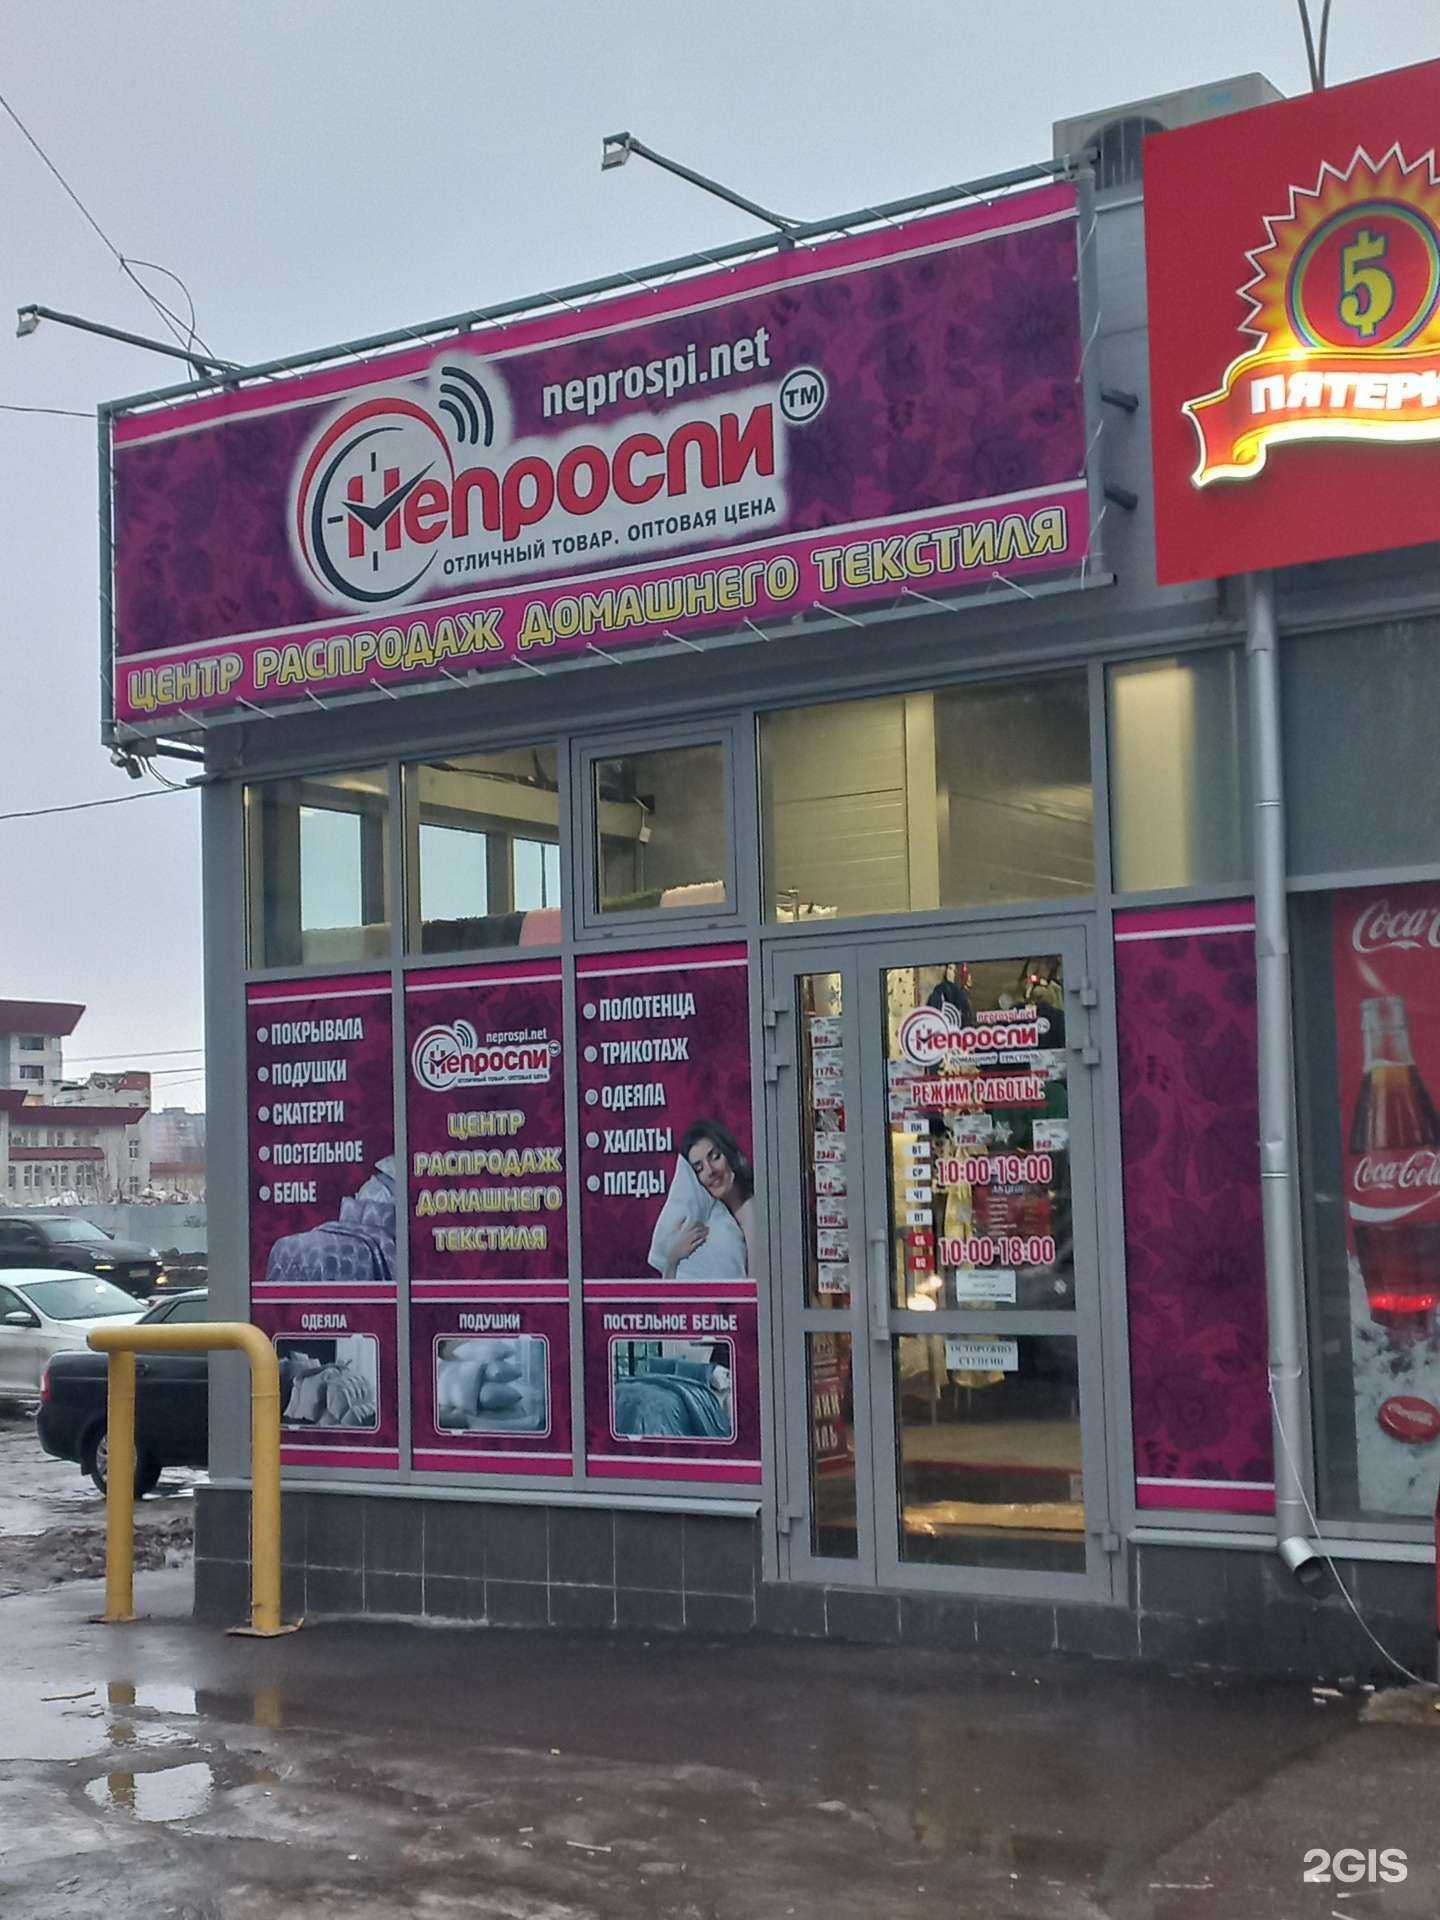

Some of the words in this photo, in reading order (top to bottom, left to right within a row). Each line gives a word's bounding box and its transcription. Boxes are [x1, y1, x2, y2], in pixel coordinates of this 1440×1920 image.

[543, 327, 771, 417] neprospi.net
[443, 539, 546, 576] ОТЛИЧНЫЙ
[552, 529, 620, 556] ТОВАР.
[627, 508, 717, 542] ОПТОВАЯ
[724, 496, 777, 524] ЦЕНА
[128, 654, 242, 711] ЦЕНТР
[255, 608, 503, 689] РАСПРОДАЖ
[519, 556, 799, 648] ДОМАШНЕГО
[812, 506, 1067, 592] ТЕКСТИЛЯ
[600, 992, 696, 1021] ПОЛОТЕНЦА
[271, 1017, 364, 1045] ПОКРЫВАЛА
[486, 1028, 547, 1043] neprospi.net
[601, 1037, 690, 1064] ТРИКОТАЖ
[272, 1059, 347, 1088] ПОДУШКИ
[601, 1083, 666, 1112] ОДЕЯЛА
[912, 1081, 974, 1104] РЕЖИМ
[976, 1077, 1045, 1102] РАБОТЫ:
[273, 1101, 344, 1125] СКАТЕРТИ
[447, 1110, 526, 1141] ЦЕНТР
[273, 1140, 364, 1165] ПОСТЕЛЬНОЕ
[603, 1126, 673, 1154] ХАЛАТЫ
[413, 1148, 562, 1177] РАСПРОДАЖ
[912, 1167, 923, 1177] СР
[936, 1155, 1052, 1185] 10:00-19:00
[274, 1181, 317, 1203] БЕЛЬЕ
[604, 1170, 666, 1198] ПЛЕДЫ
[914, 1190, 923, 1199] ЧТ
[416, 1186, 563, 1217] ДОМАШНЕГО
[914, 1212, 923, 1222] ПТ
[431, 1225, 548, 1252] ТЕКСТИЛЯ
[939, 1236, 1055, 1266] 10:00-18:00
[301, 1313, 348, 1332] ОДЕЯЛА
[458, 1312, 521, 1331] ПОДУШКИ
[604, 1313, 687, 1331] ПОСТЕЛЬНОЕ
[692, 1313, 739, 1332] БЕЛЬЕ
